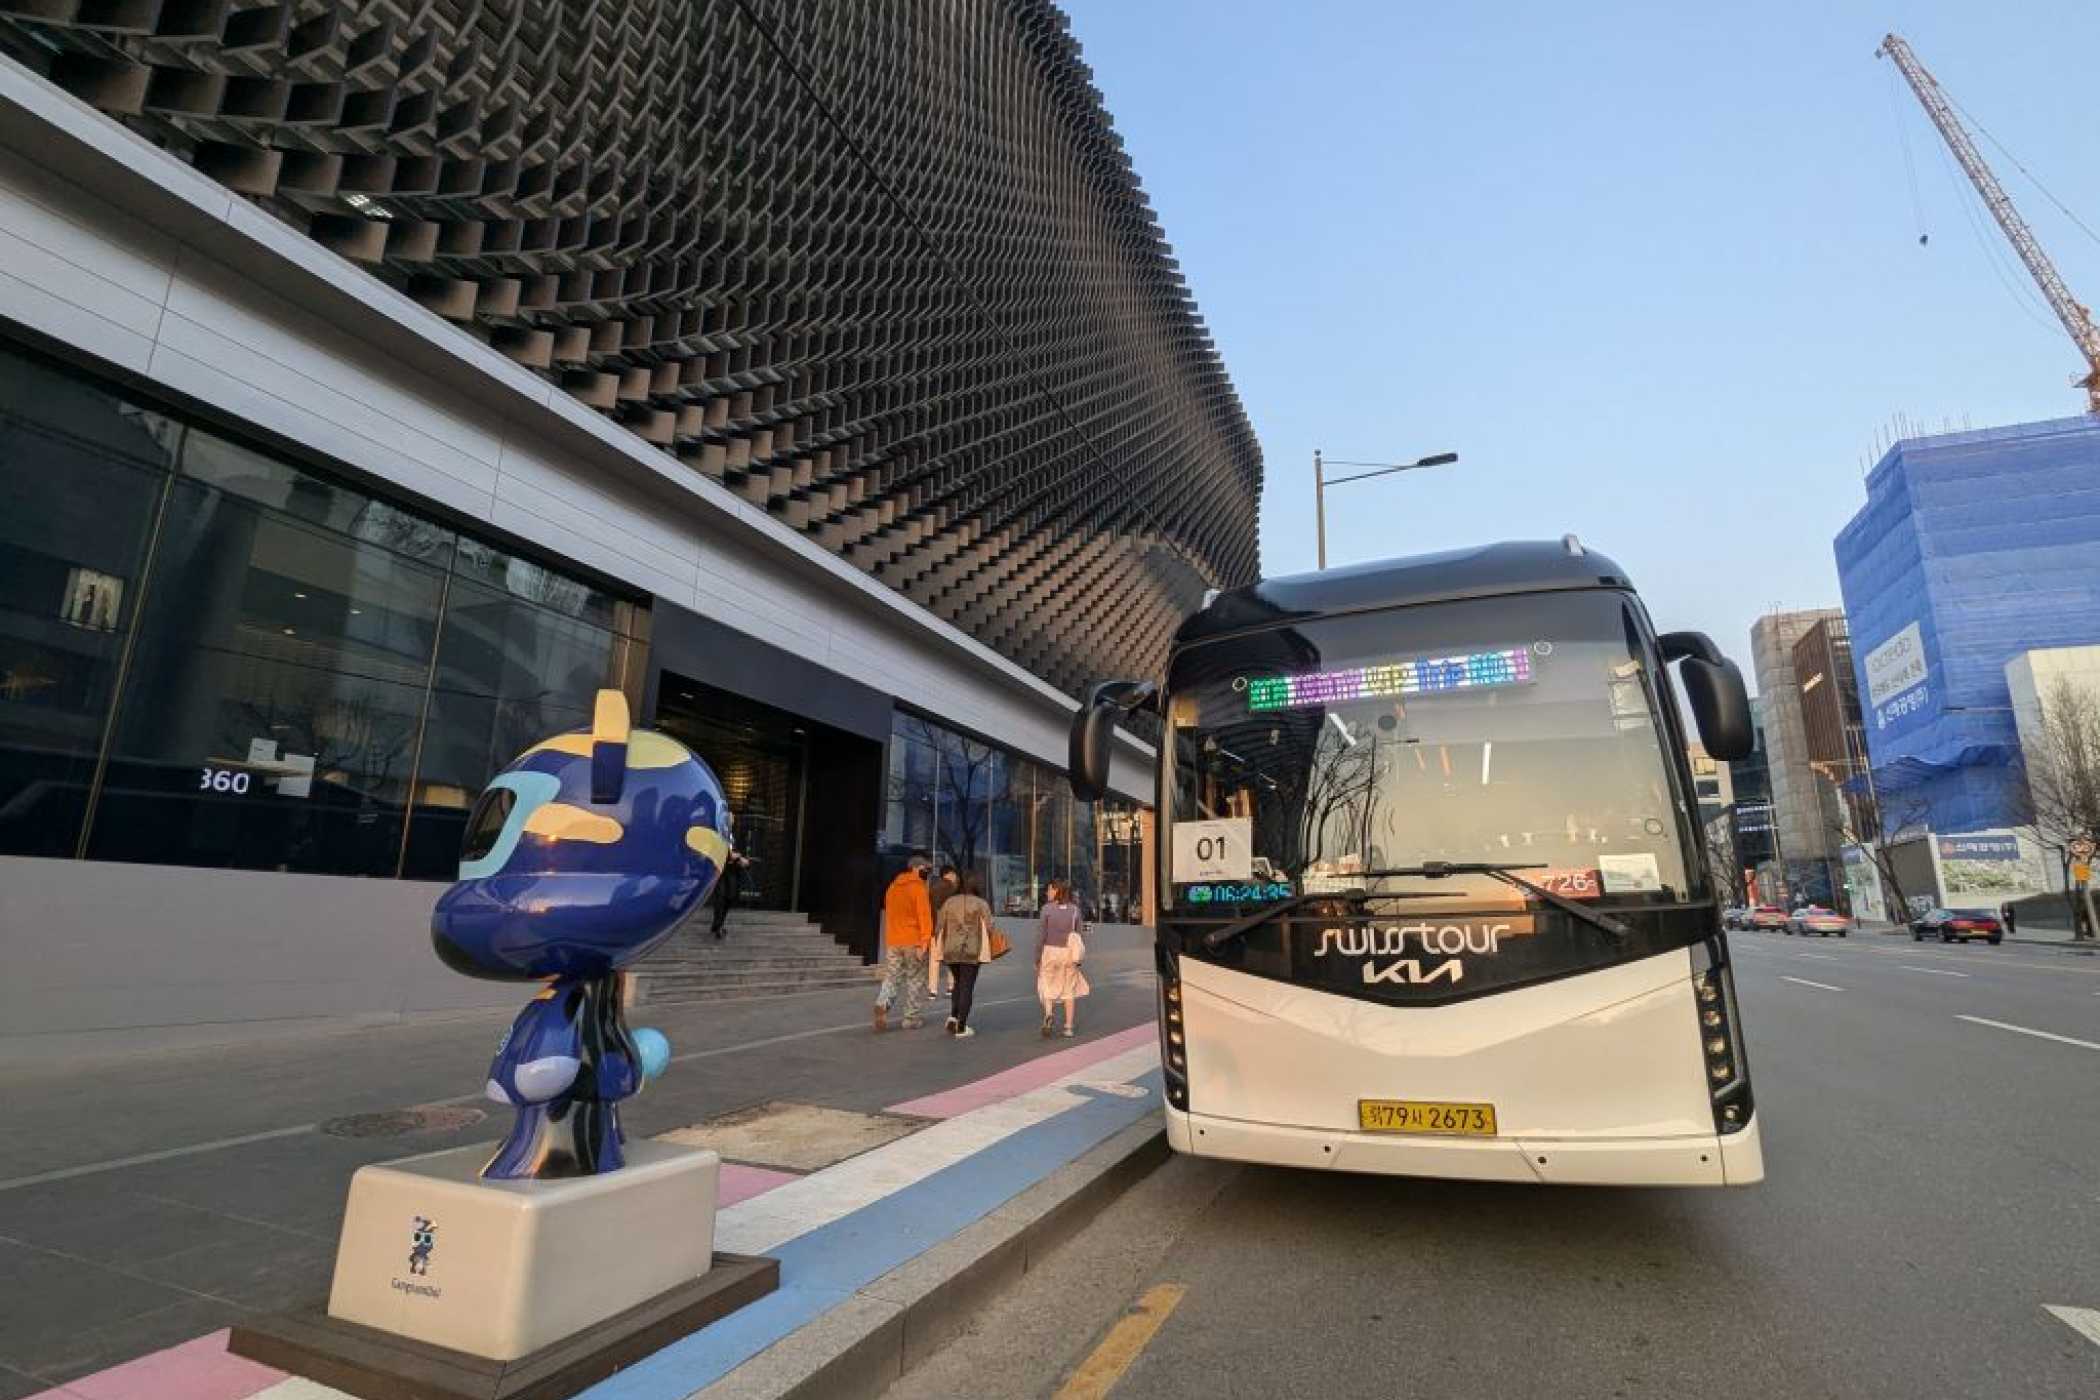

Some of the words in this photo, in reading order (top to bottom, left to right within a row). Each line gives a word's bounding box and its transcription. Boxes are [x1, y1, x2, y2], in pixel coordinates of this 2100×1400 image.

[200, 768, 250, 794] 360
[1197, 837, 1225, 860] 01
[1314, 923, 1511, 957] swisstour
[1362, 959, 1463, 984] KIA
[1428, 1107, 1486, 1129] 2673
